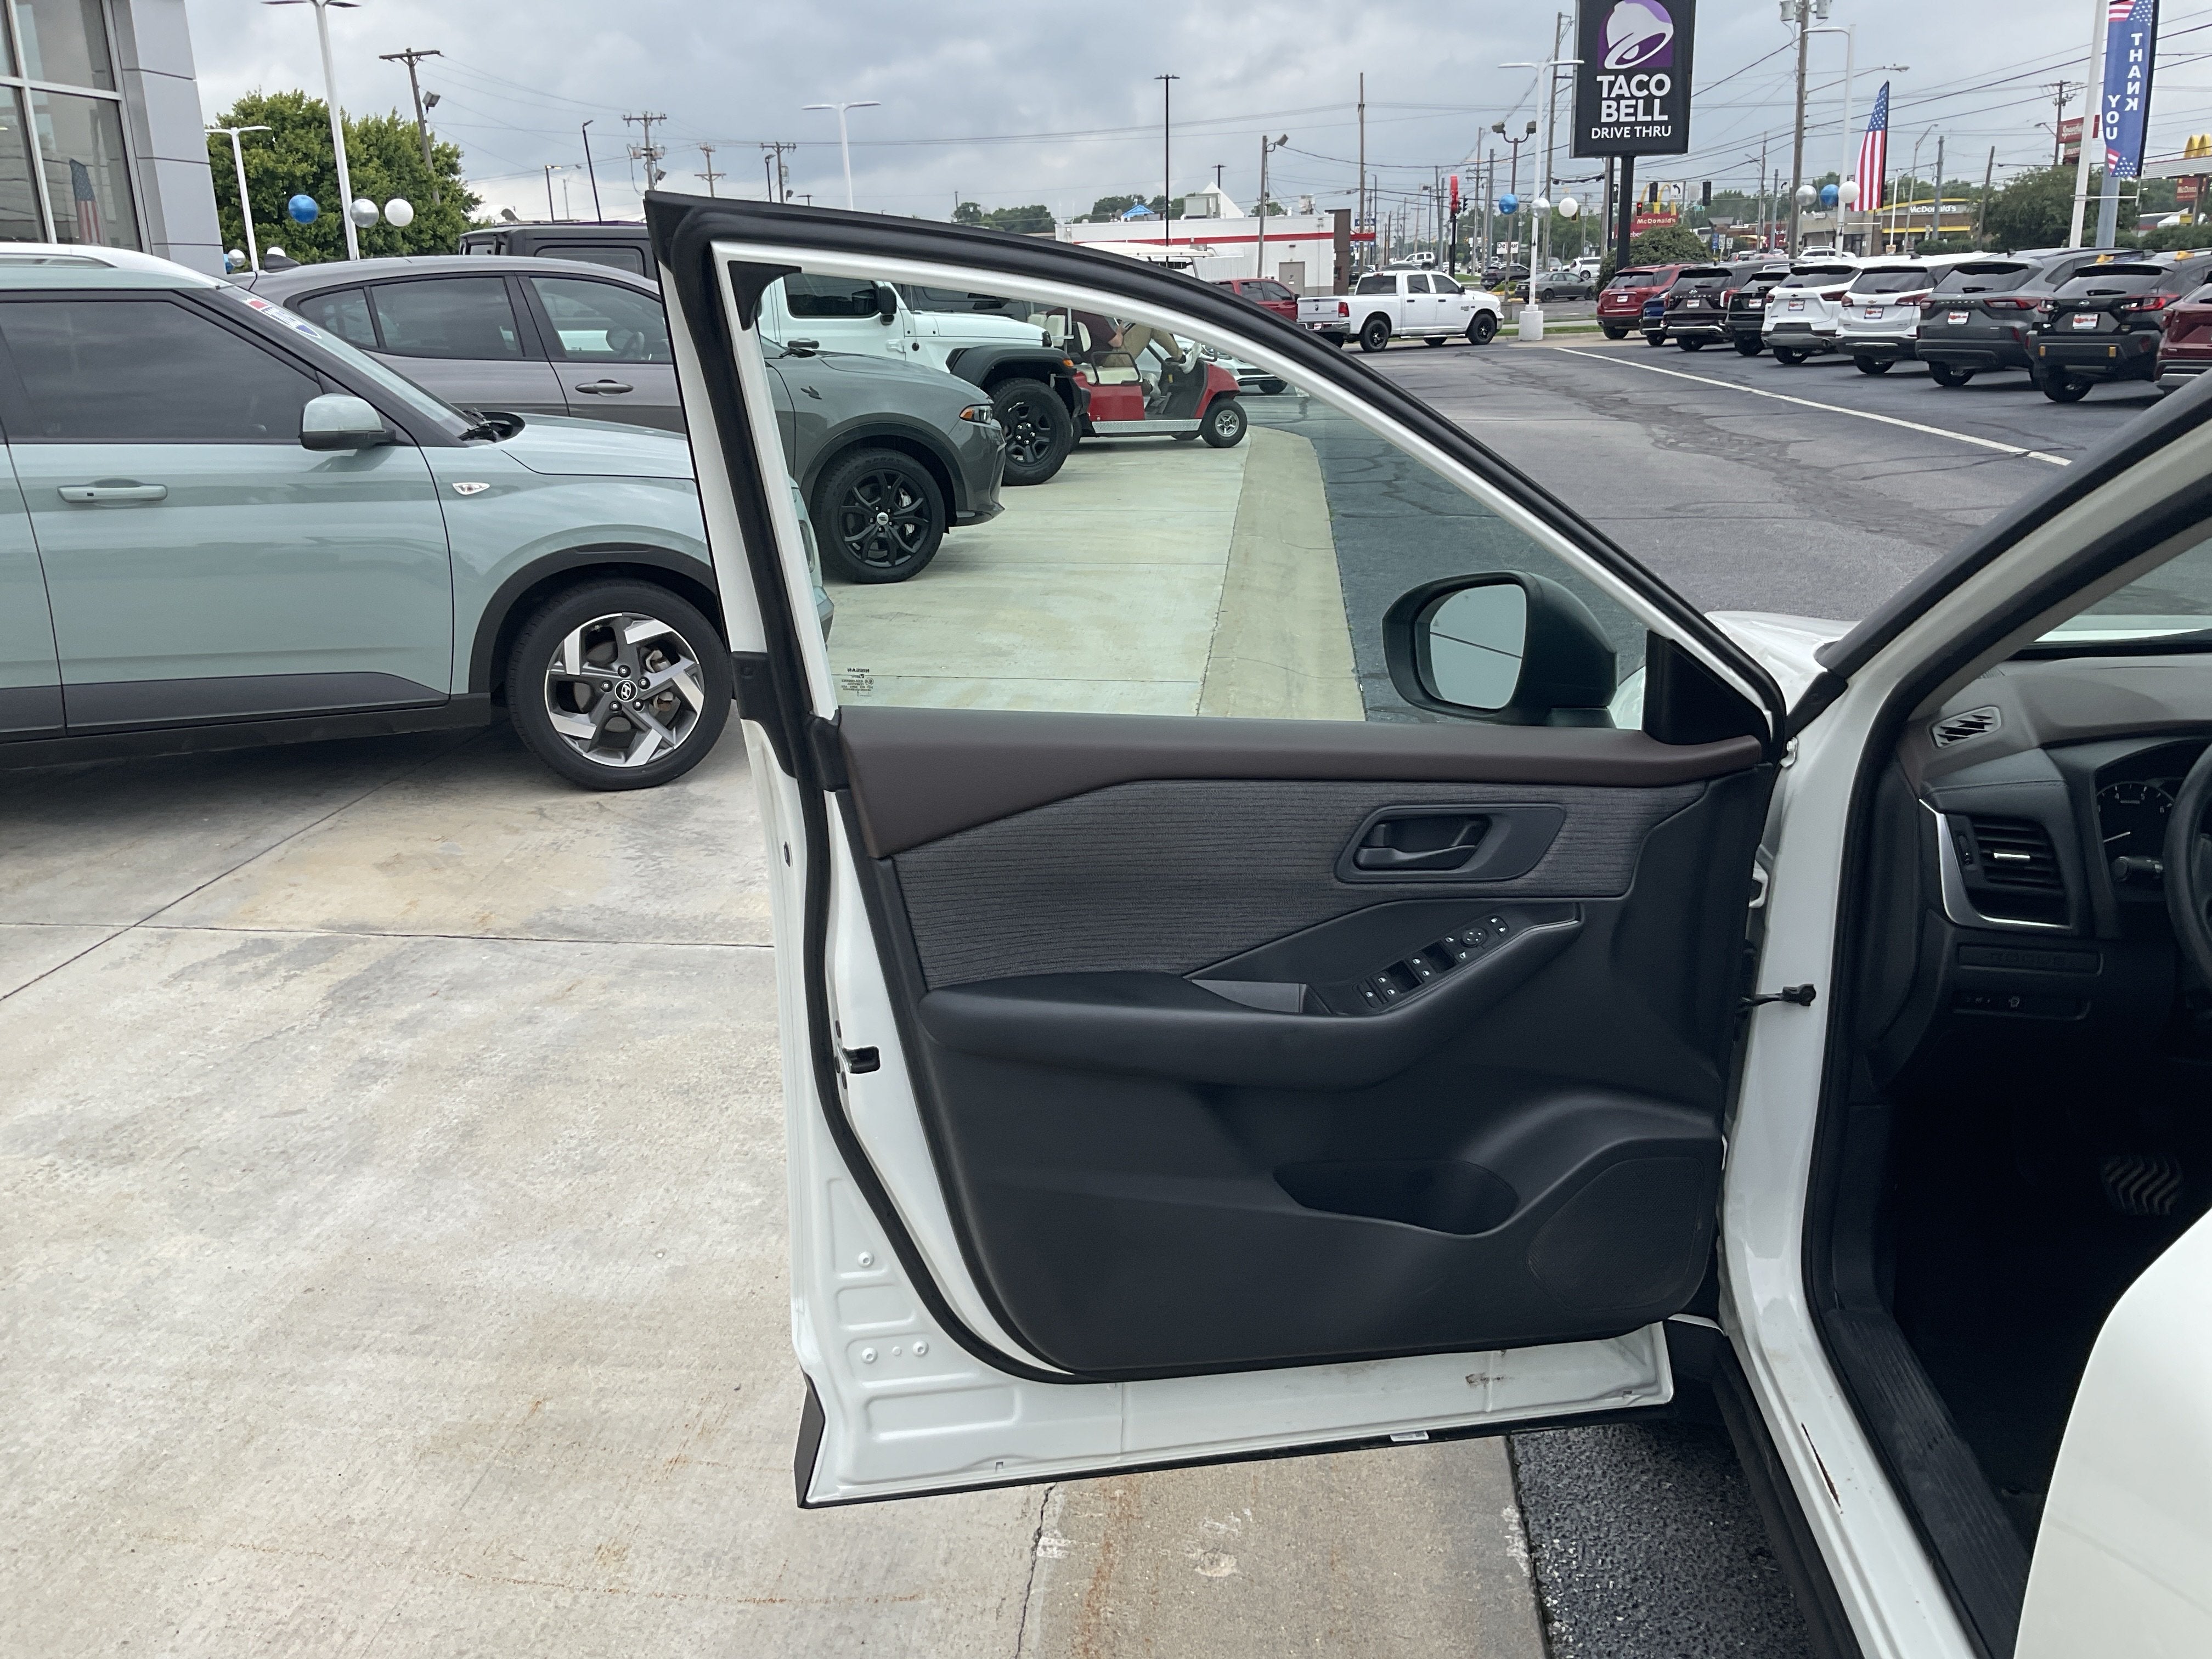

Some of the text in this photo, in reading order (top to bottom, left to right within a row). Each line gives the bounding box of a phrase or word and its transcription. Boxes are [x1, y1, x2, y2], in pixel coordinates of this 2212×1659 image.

[1596, 74, 1671, 98] TACO
[1601, 99, 1668, 122] BELL
[1591, 126, 1672, 139] DRIVE THRU
